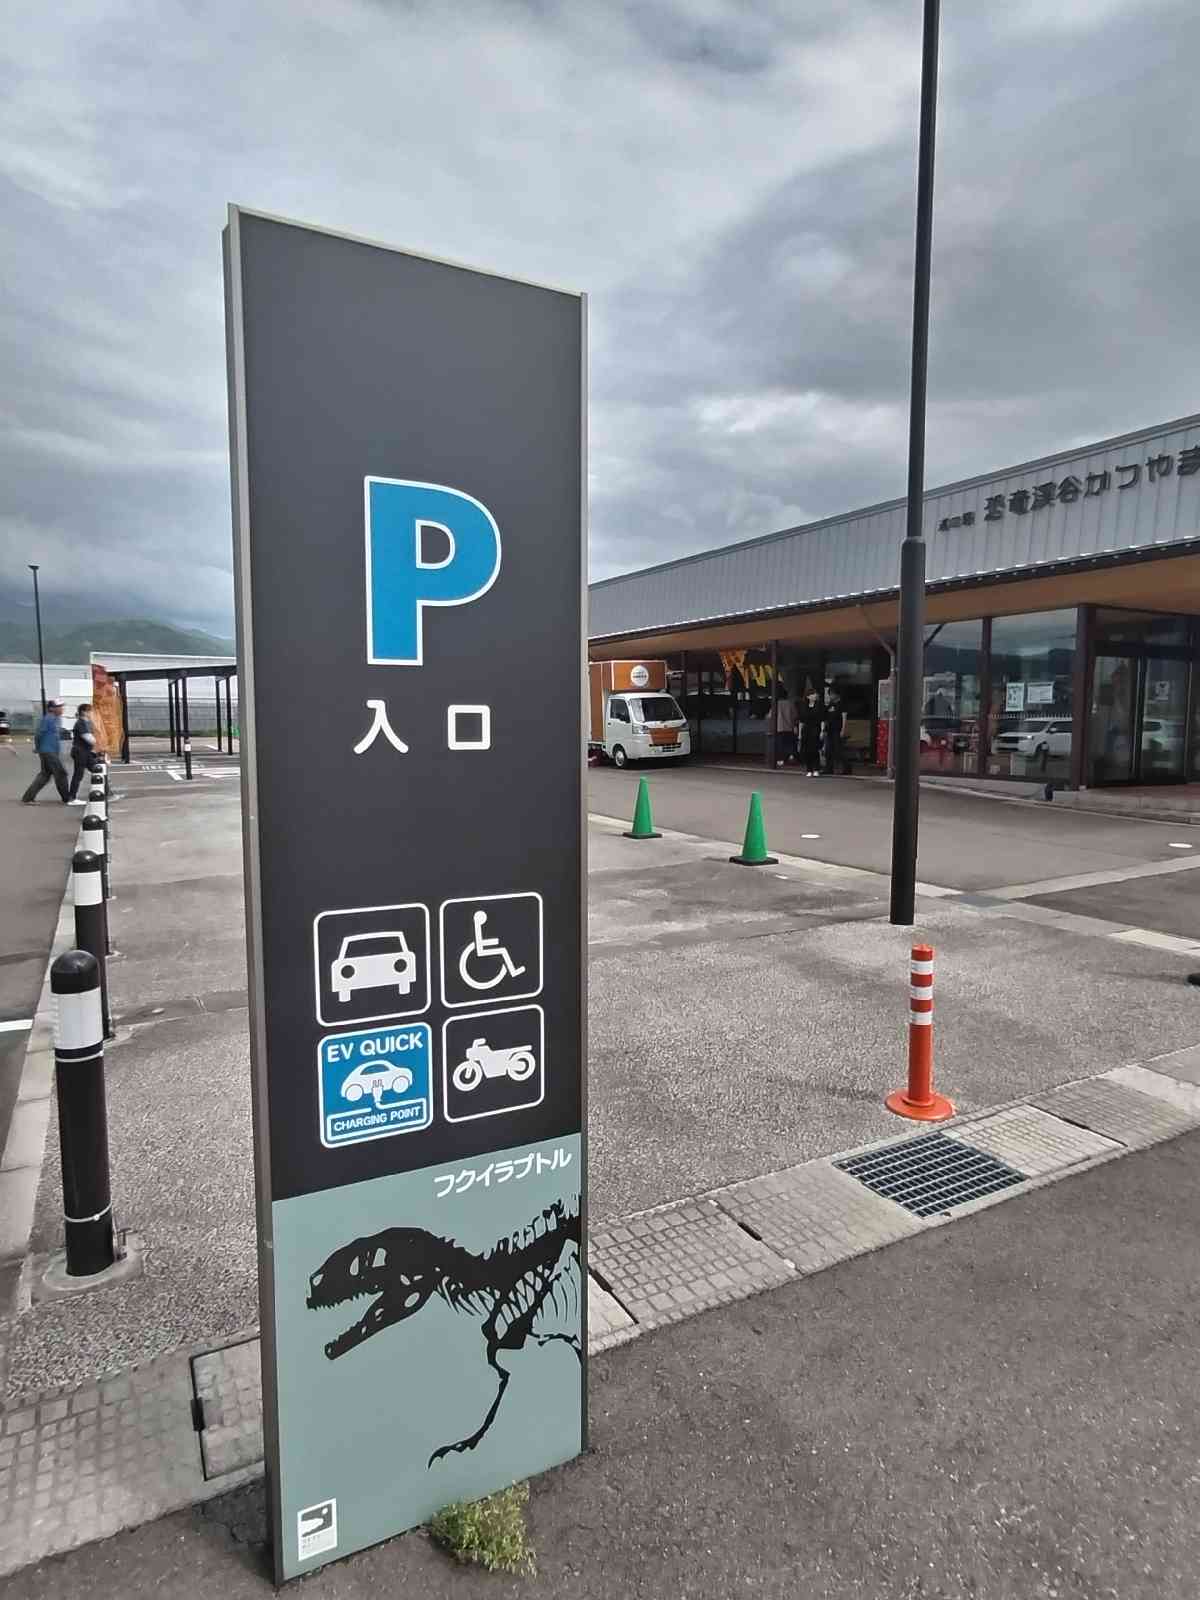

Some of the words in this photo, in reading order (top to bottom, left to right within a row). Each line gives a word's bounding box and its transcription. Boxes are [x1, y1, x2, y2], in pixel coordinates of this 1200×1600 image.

[364, 475, 502, 666] P
[353, 699, 491, 754] 入口
[327, 1042, 354, 1063] EV
[359, 1031, 424, 1057] QUICK
[333, 1112, 388, 1132] CHARGING
[390, 1105, 421, 1121] POINT
[434, 1148, 573, 1198] フクイラプトル
